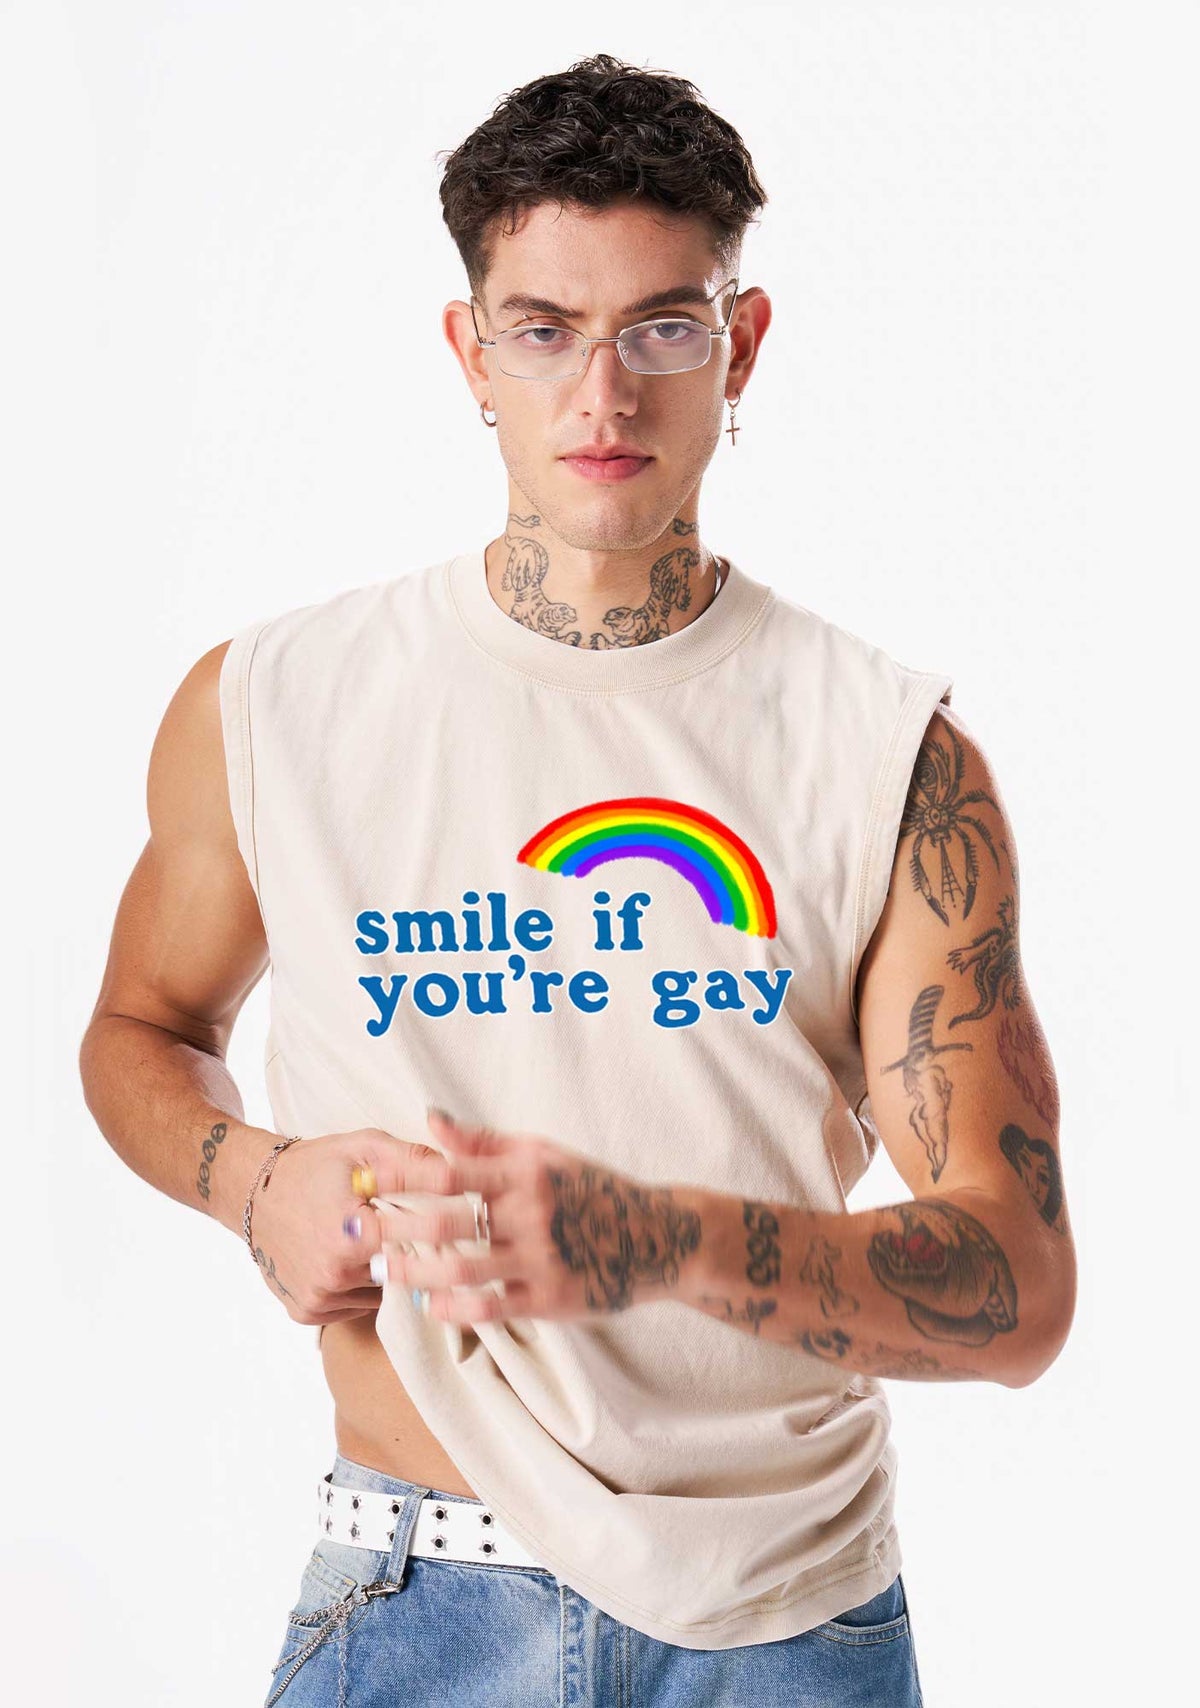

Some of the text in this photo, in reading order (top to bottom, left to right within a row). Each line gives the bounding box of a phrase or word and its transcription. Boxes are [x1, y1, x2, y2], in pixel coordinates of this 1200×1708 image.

[355, 891, 651, 954] smile if
[358, 954, 792, 1037] you're gay
